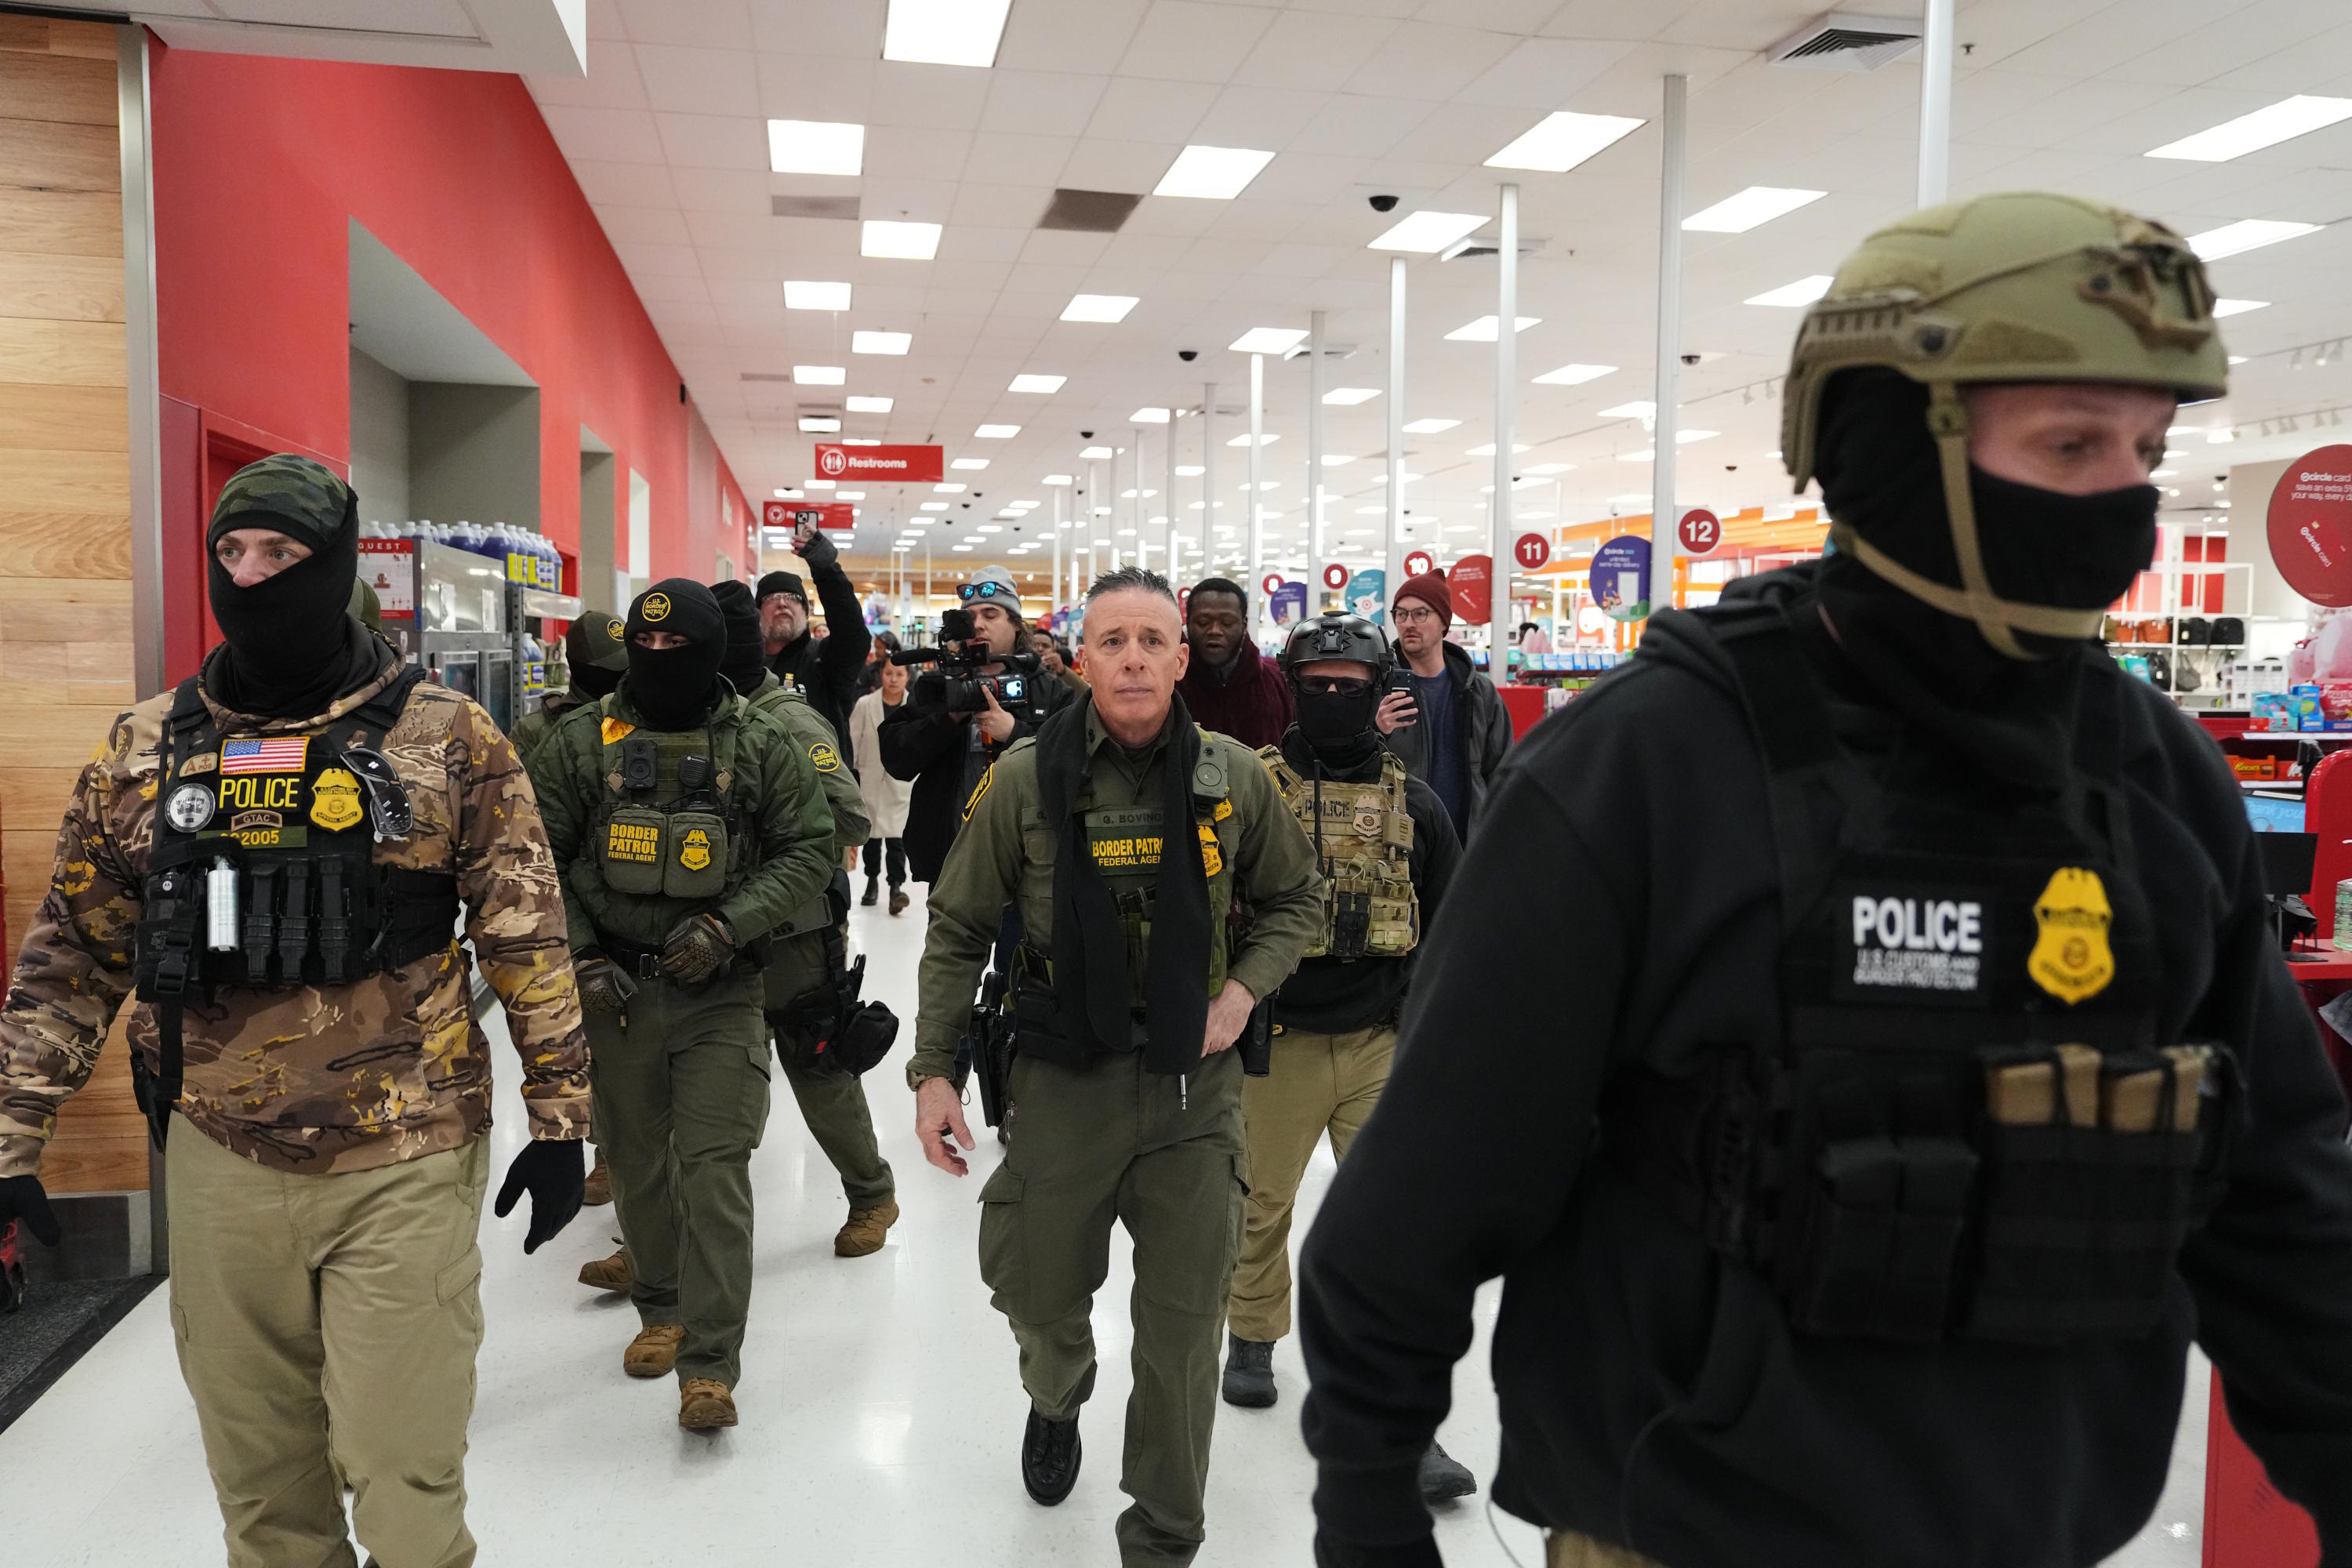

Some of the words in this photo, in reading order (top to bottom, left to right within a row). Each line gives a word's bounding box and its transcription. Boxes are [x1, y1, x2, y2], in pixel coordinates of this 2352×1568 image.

[848, 457, 908, 469] Restrooms
[1686, 521, 1713, 543] 12
[1523, 542, 1541, 561] 11
[1409, 557, 1428, 575] 10
[1330, 568, 1342, 586] 9
[219, 778, 300, 809] POLICE
[1305, 799, 1350, 817] PLICE
[243, 814, 270, 823] GTAC
[1103, 815, 1114, 824] G.
[220, 830, 280, 846] 2005
[610, 823, 659, 841] BORDER
[608, 838, 657, 855] PATROL
[1092, 839, 1134, 857] BORDER
[1136, 837, 1163, 855] PATR
[608, 851, 633, 861] FEDERAL
[635, 854, 656, 862] AGENT
[1098, 856, 1138, 866] FEDERAL
[1852, 895, 1984, 953] POLICE
